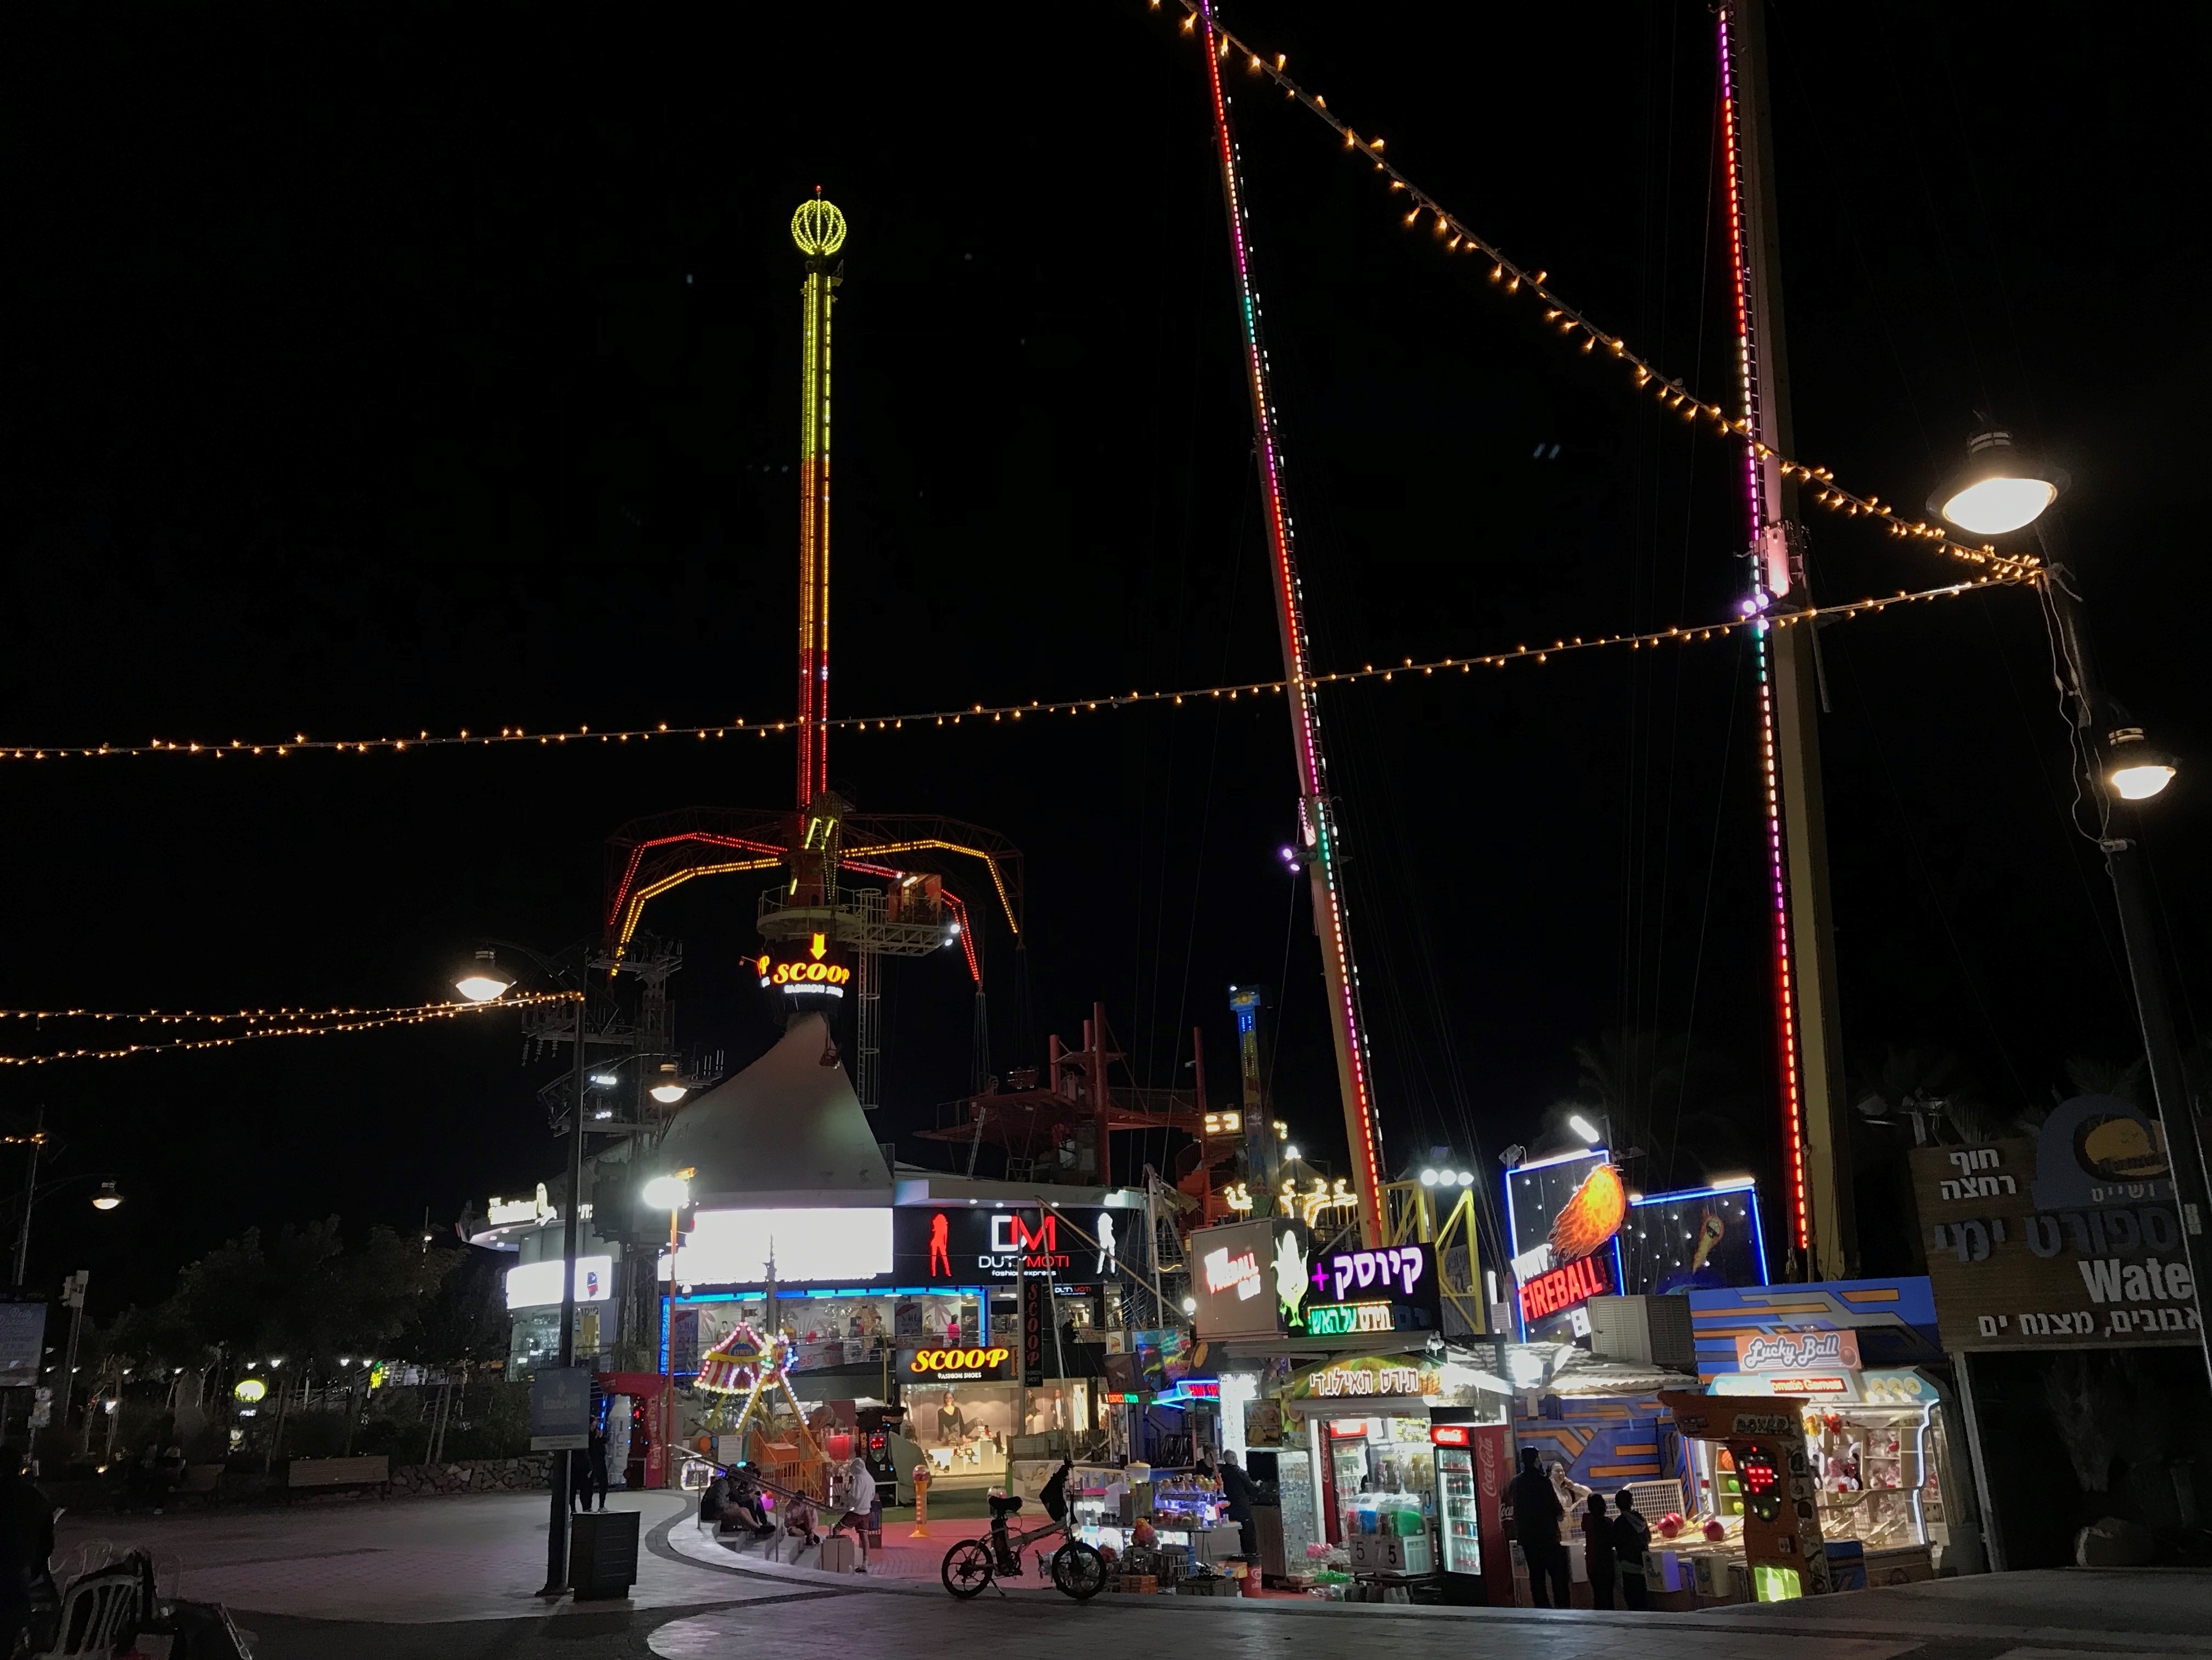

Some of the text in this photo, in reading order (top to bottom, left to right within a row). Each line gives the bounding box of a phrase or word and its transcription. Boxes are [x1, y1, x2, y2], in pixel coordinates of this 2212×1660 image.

[773, 963, 850, 985] SCOOP
[1948, 1148, 2001, 1176] חוף
[1940, 1175, 2018, 1201] רחצה
[1933, 1206, 2179, 1263] ספורט ימי
[1026, 1255, 1069, 1268] MOTI
[1334, 1247, 1423, 1301] קיוסק
[1027, 1283, 1039, 1367] SCOOP
[1358, 1305, 1391, 1332] תירס
[1978, 1315, 2008, 1338] ים
[2018, 1310, 2095, 1335] מצנח
[910, 1348, 1009, 1372] SCOOP
[1744, 1333, 1840, 1370] Lucky Ball
[1309, 1367, 1419, 1396] תירס תאילנדי
[615, 1420, 625, 1457] ICE
[1356, 1541, 1365, 1560] 5
[1388, 1545, 1397, 1564] 5
